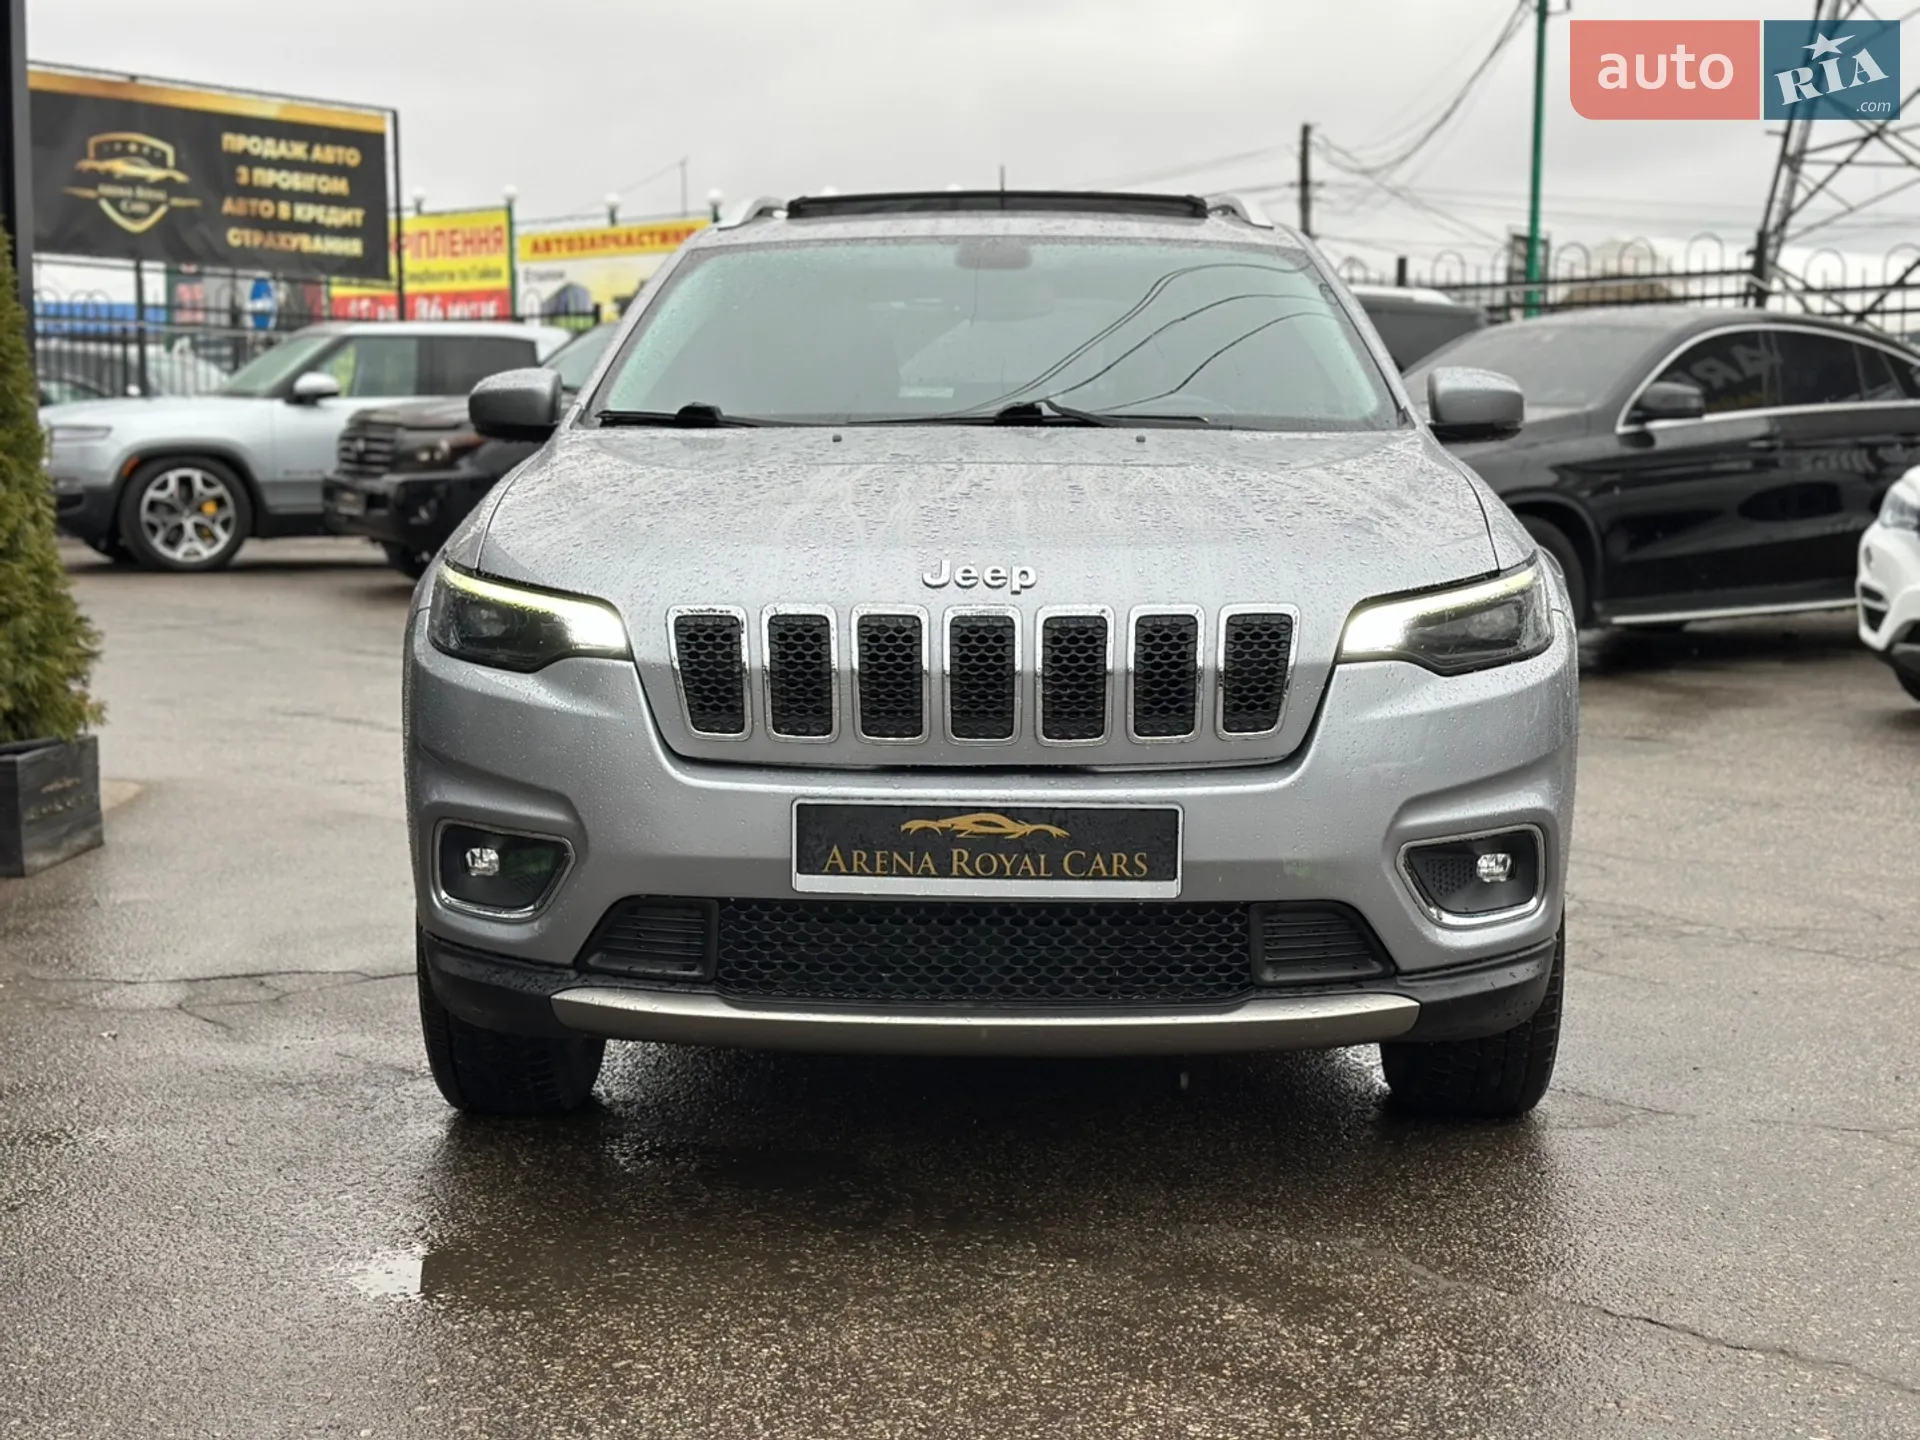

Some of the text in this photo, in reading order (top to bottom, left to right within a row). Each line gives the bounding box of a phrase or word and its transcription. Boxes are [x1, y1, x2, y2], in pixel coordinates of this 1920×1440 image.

[221, 132, 362, 168] ПРОДАЖ АВТО
[221, 197, 276, 219] АВТО
[293, 202, 365, 229] КРЕДИТ
[226, 226, 364, 258] СТРАХУВАННЯ
[922, 559, 1037, 595] Jeep
[822, 844, 1148, 878] ARENA ROYAL CARS
